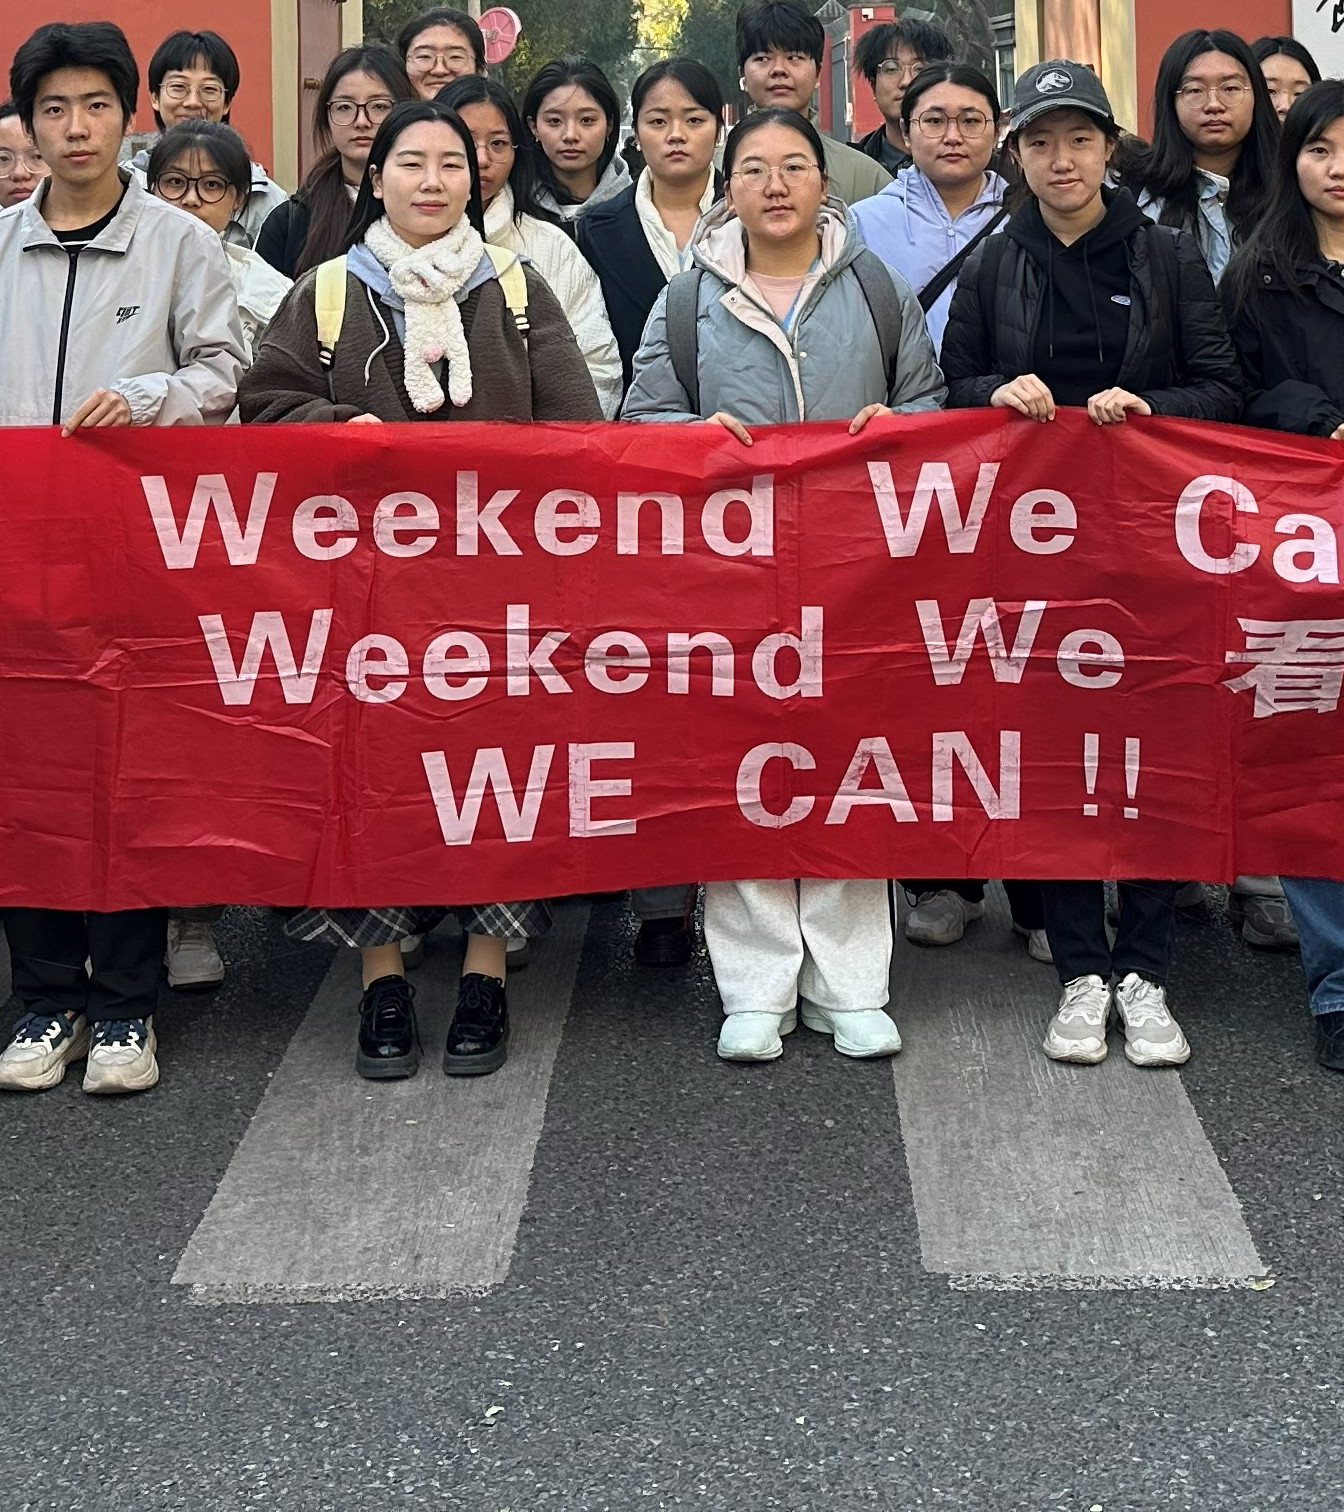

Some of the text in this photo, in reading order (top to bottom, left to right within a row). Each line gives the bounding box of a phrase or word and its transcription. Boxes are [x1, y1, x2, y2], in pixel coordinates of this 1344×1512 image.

[140, 470, 774, 570] Weekend
[866, 461, 1078, 557] We
[198, 603, 824, 704] Weekend
[915, 596, 1125, 688] We
[420, 741, 637, 847] WE
[736, 730, 1022, 830] CAN
